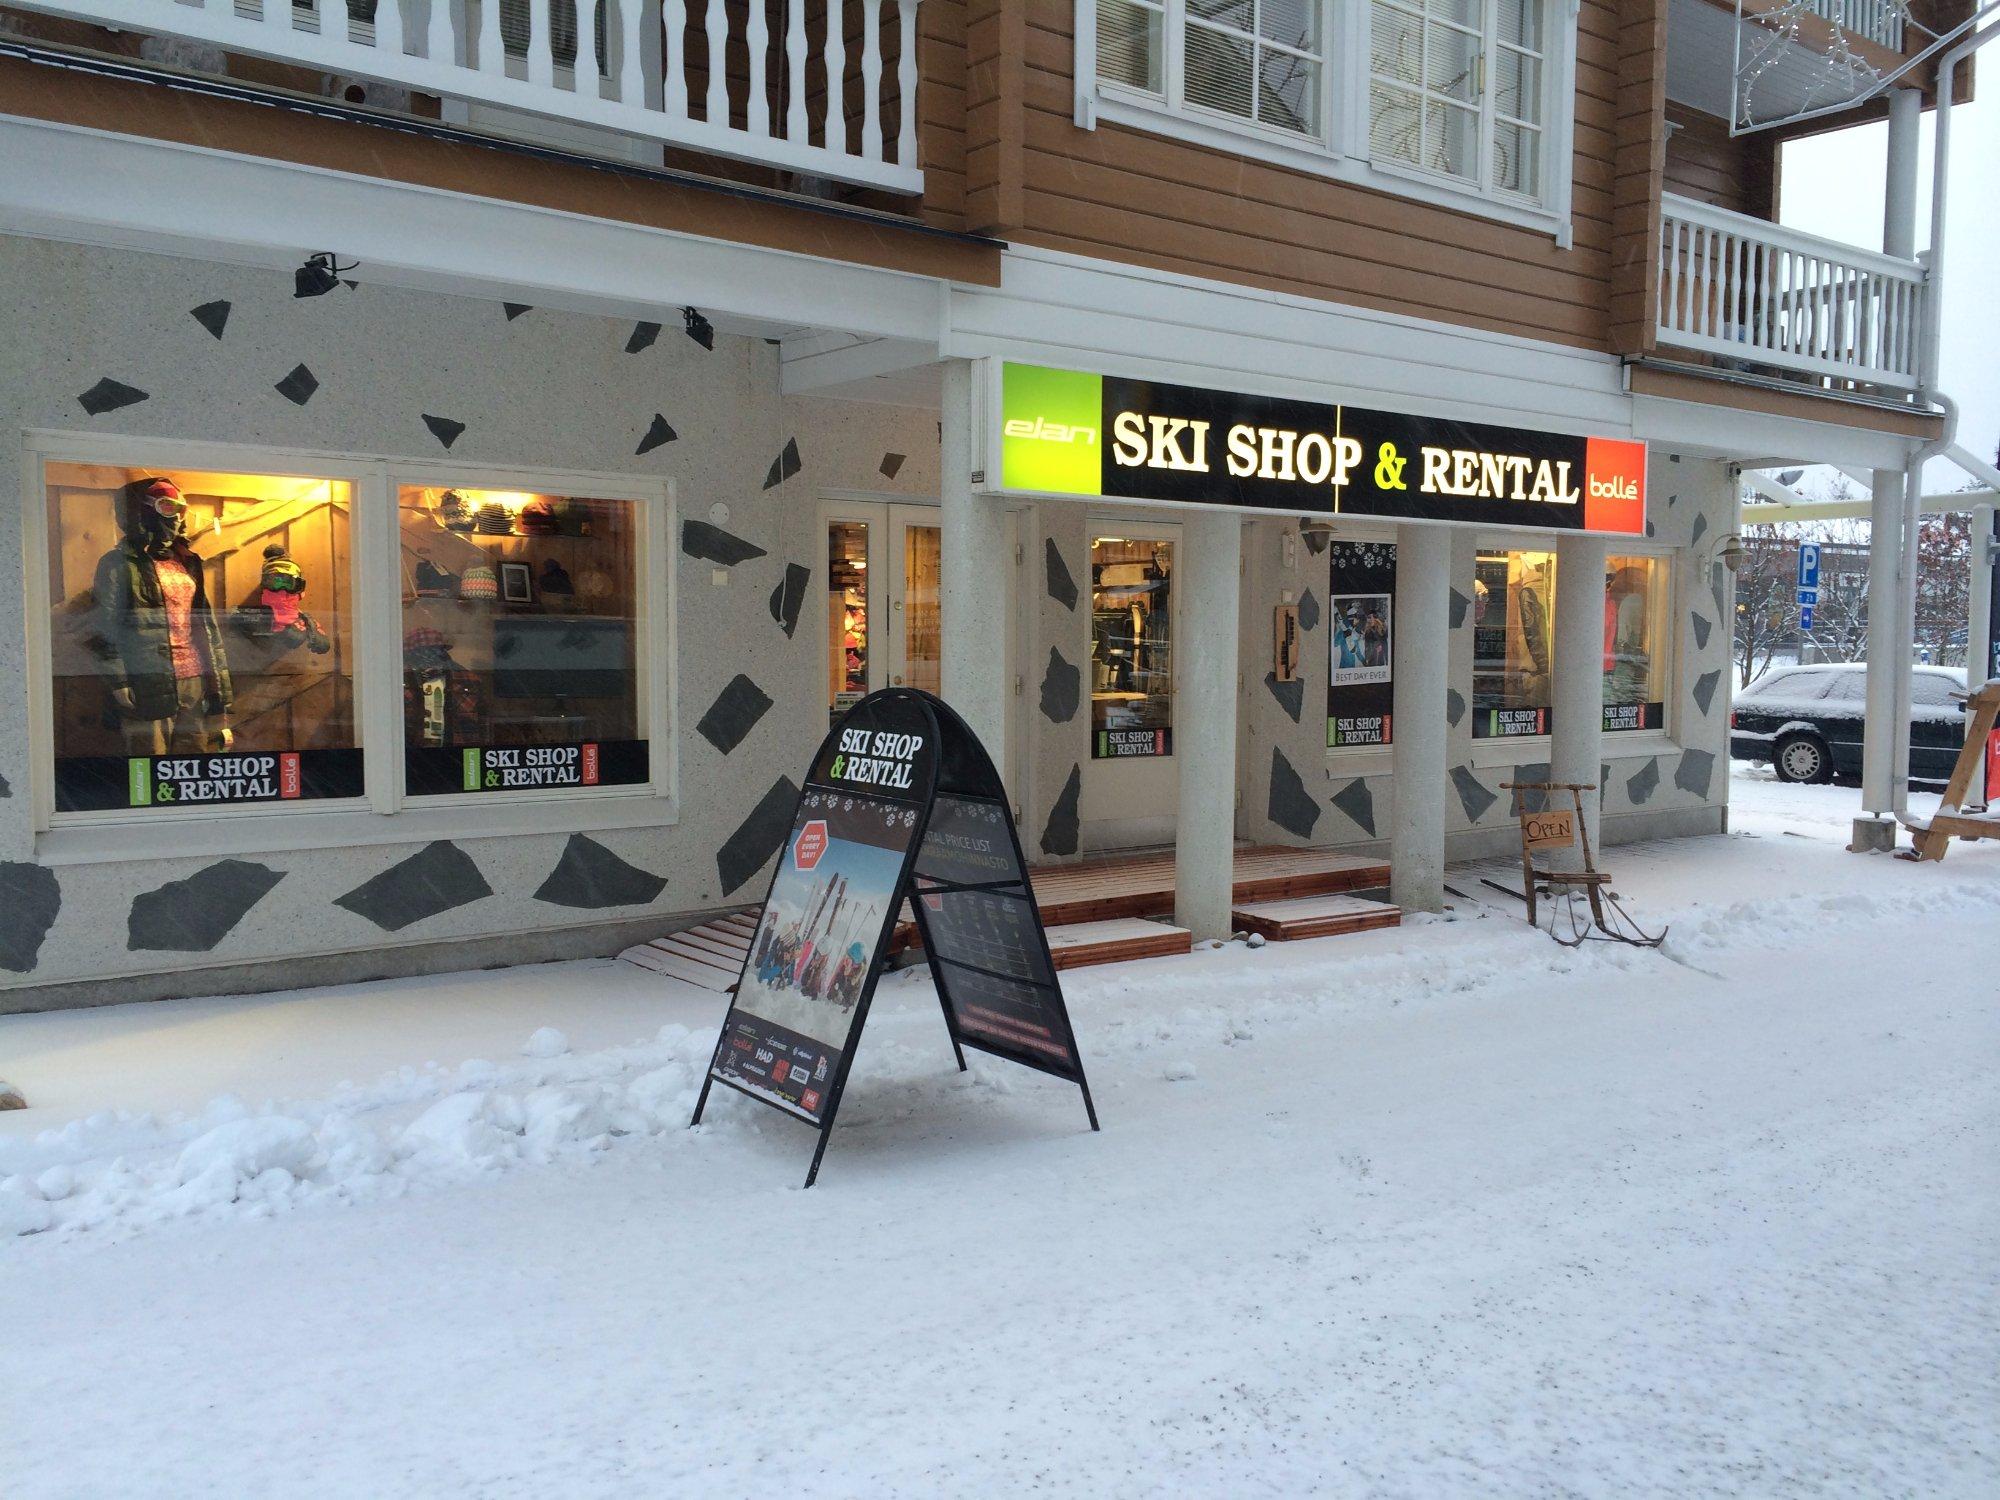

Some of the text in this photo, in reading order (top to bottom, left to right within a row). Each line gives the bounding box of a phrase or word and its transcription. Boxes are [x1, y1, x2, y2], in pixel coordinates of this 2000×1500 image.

[1004, 417, 1096, 444] elan
[1112, 411, 1580, 504] SKI SHOP & RENTAL
[1589, 473, 1638, 500] bollé
[1802, 547, 1817, 584] P
[1335, 671, 1387, 682] BEST DAY EVER
[1499, 711, 1513, 723] SKI
[1514, 710, 1536, 722] SHOP
[1605, 706, 1617, 718] SKI
[1618, 706, 1638, 717] SHOP
[1337, 718, 1354, 731] SKI
[1356, 717, 1382, 730] SHOP
[1505, 722, 1536, 734] RENTAL
[1610, 717, 1638, 728] RENTAL
[839, 728, 923, 760] SKI SHOP
[1109, 732, 1126, 743] SKI
[1128, 731, 1154, 743] SHOP
[1338, 732, 1344, 743] &
[1345, 730, 1382, 744] RENTAL
[485, 747, 579, 768] SKI SHOP
[1117, 743, 1155, 755] RENTAL
[157, 757, 275, 780] SKI SHOP
[485, 766, 580, 787] & RENTAL
[830, 755, 912, 788] & RENTAL
[156, 777, 277, 801] & RENTAL
[1527, 820, 1570, 838] OPEN
[924, 831, 992, 853] NTAL PRICE LIST
[755, 1048, 774, 1063] HAD
